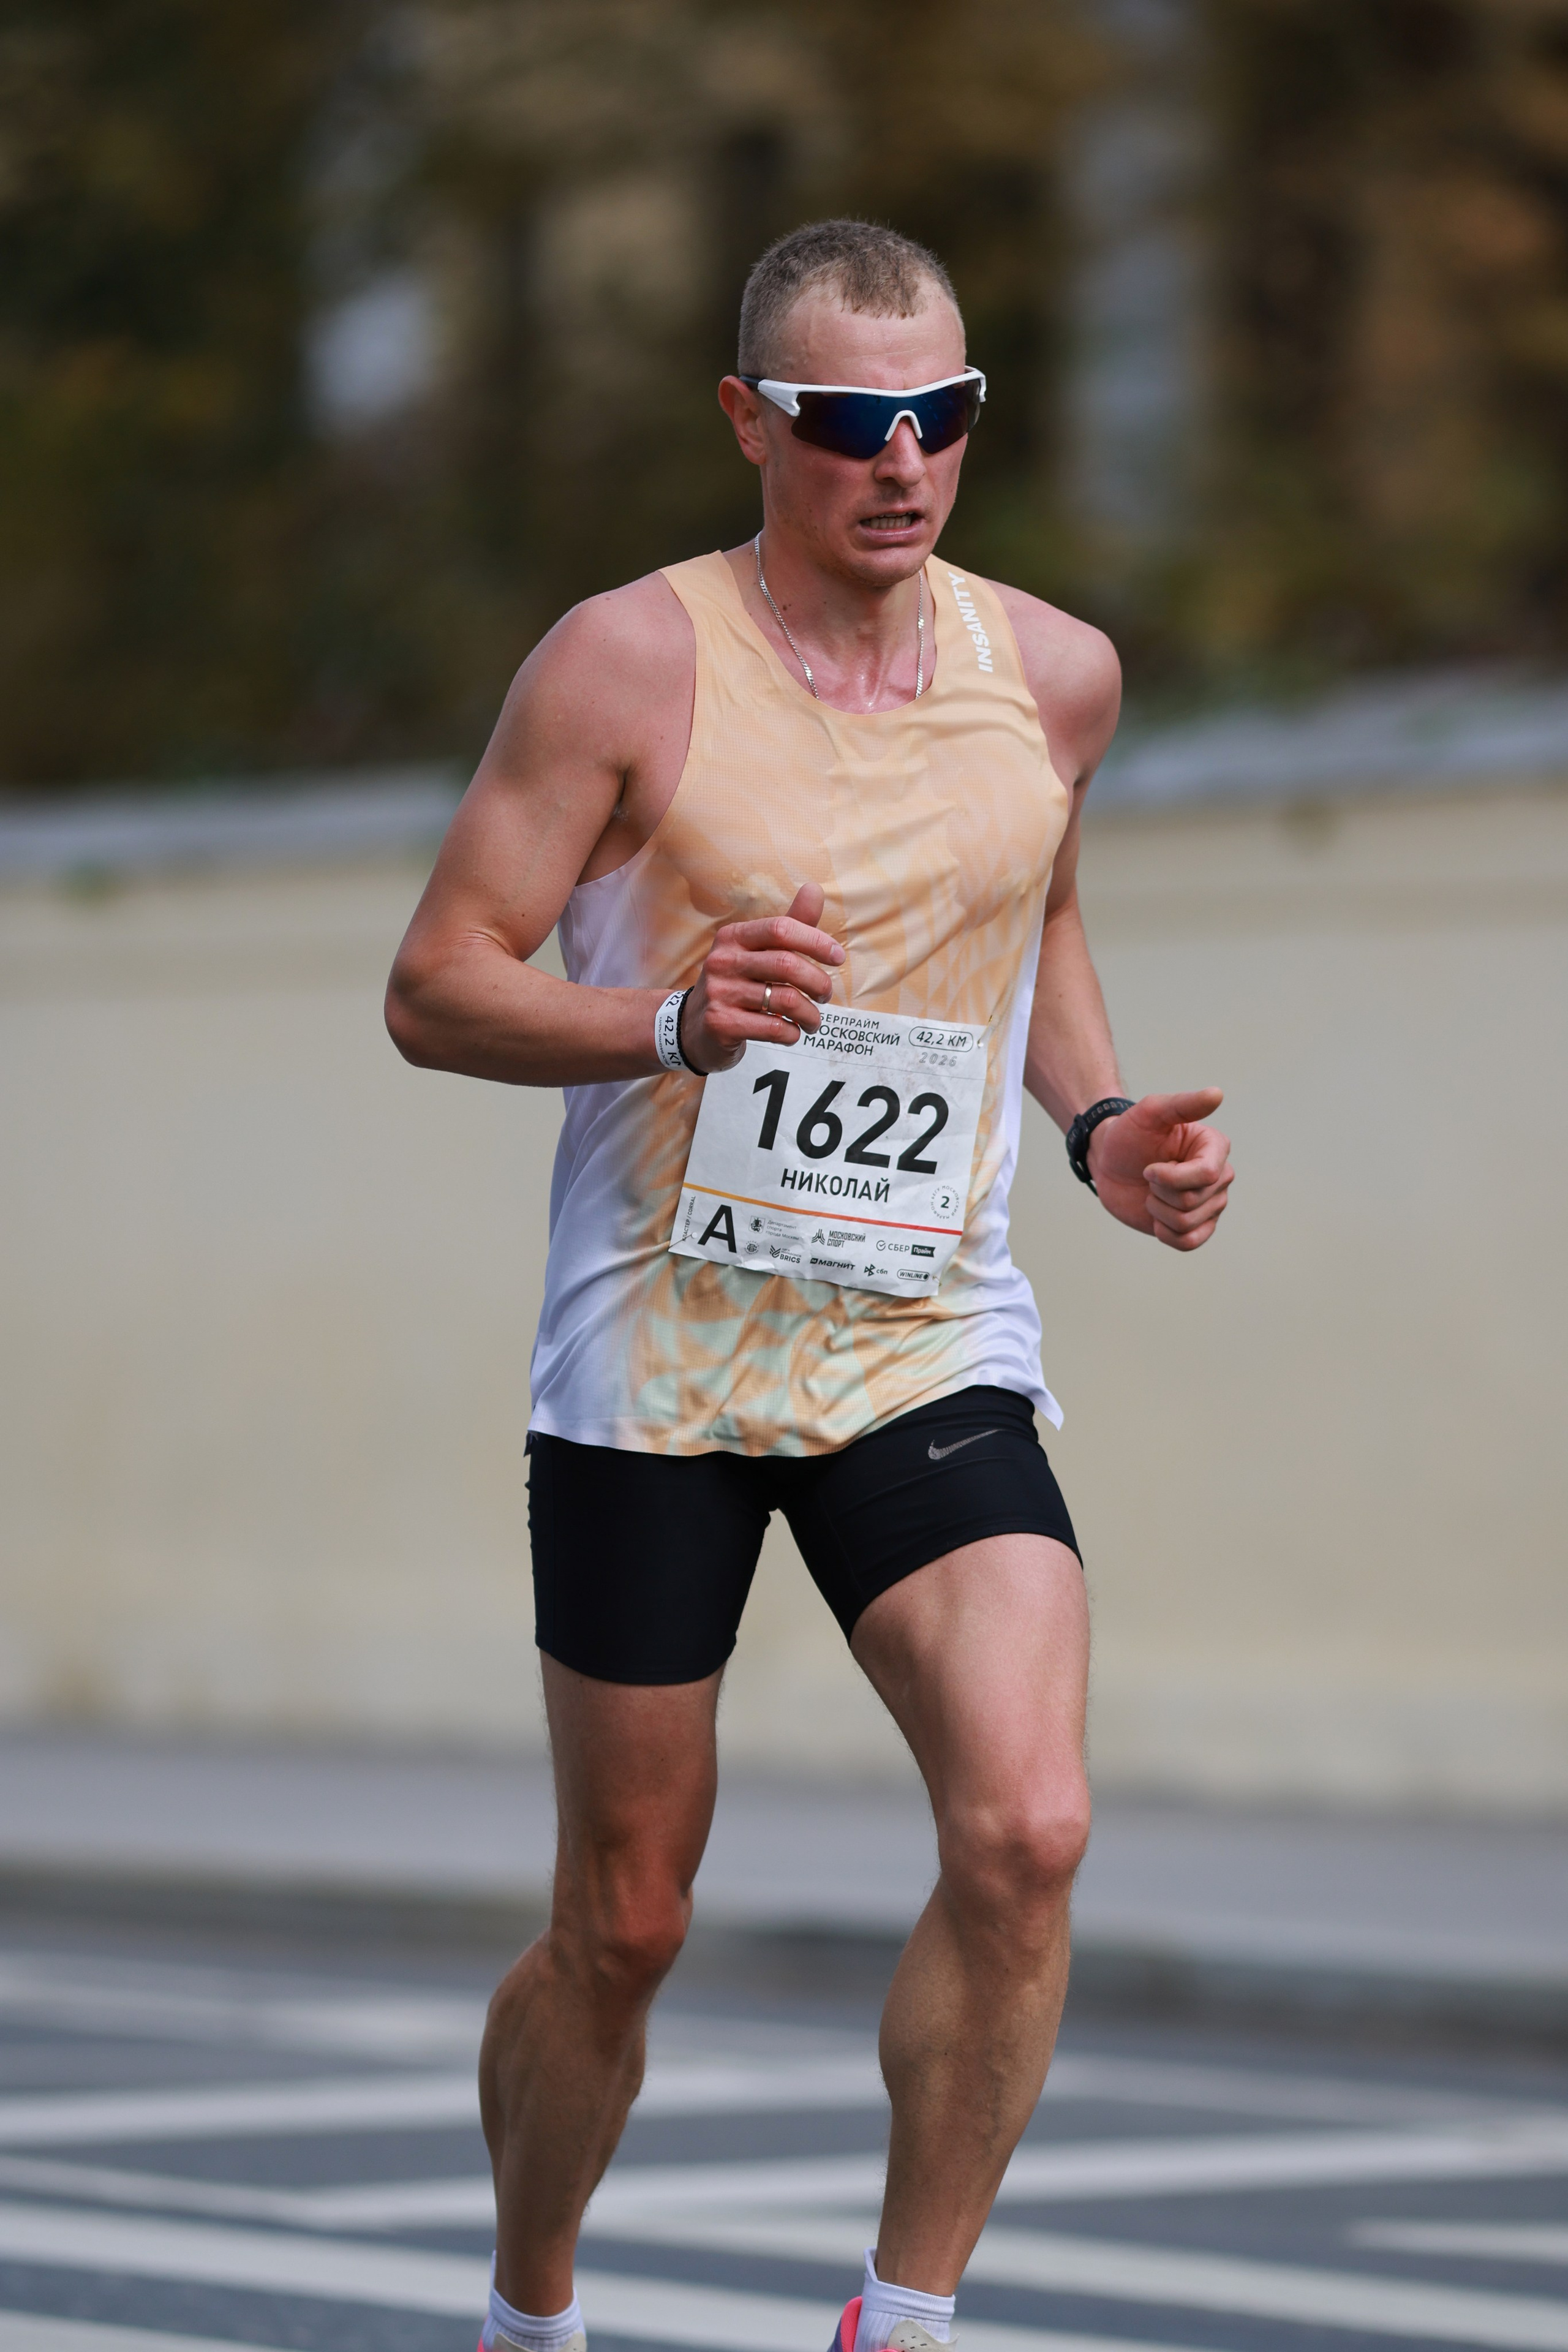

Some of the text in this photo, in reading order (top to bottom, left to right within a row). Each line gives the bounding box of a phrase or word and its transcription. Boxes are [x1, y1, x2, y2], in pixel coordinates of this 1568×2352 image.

[948, 571, 993, 673] INSANITY
[666, 990, 684, 1006] 22
[820, 1012, 880, 1030] БЕРПРАЙМ
[663, 1016, 674, 1046] 42,2
[819, 1025, 900, 1046] ОСКОВСКИЙ
[916, 1030, 967, 1047] 42,2 КМ
[804, 1035, 873, 1056] МАРАФОН
[919, 1052, 957, 1067] 2026
[753, 1069, 949, 1175] 1622
[780, 1168, 890, 1203] НИКОЛАЙ
[687, 1196, 696, 1216] CORRAL
[940, 1196, 949, 1208] 2
[767, 1219, 797, 1229] Департамент
[827, 1238, 845, 1248] СПОРТ
[828, 1230, 866, 1243] МОСКОВСКИЙ
[888, 1243, 910, 1253] СБЕР
[780, 1254, 801, 1264] BRICS
[818, 1259, 856, 1271] магнит
[899, 1271, 923, 1280] WINLINE
